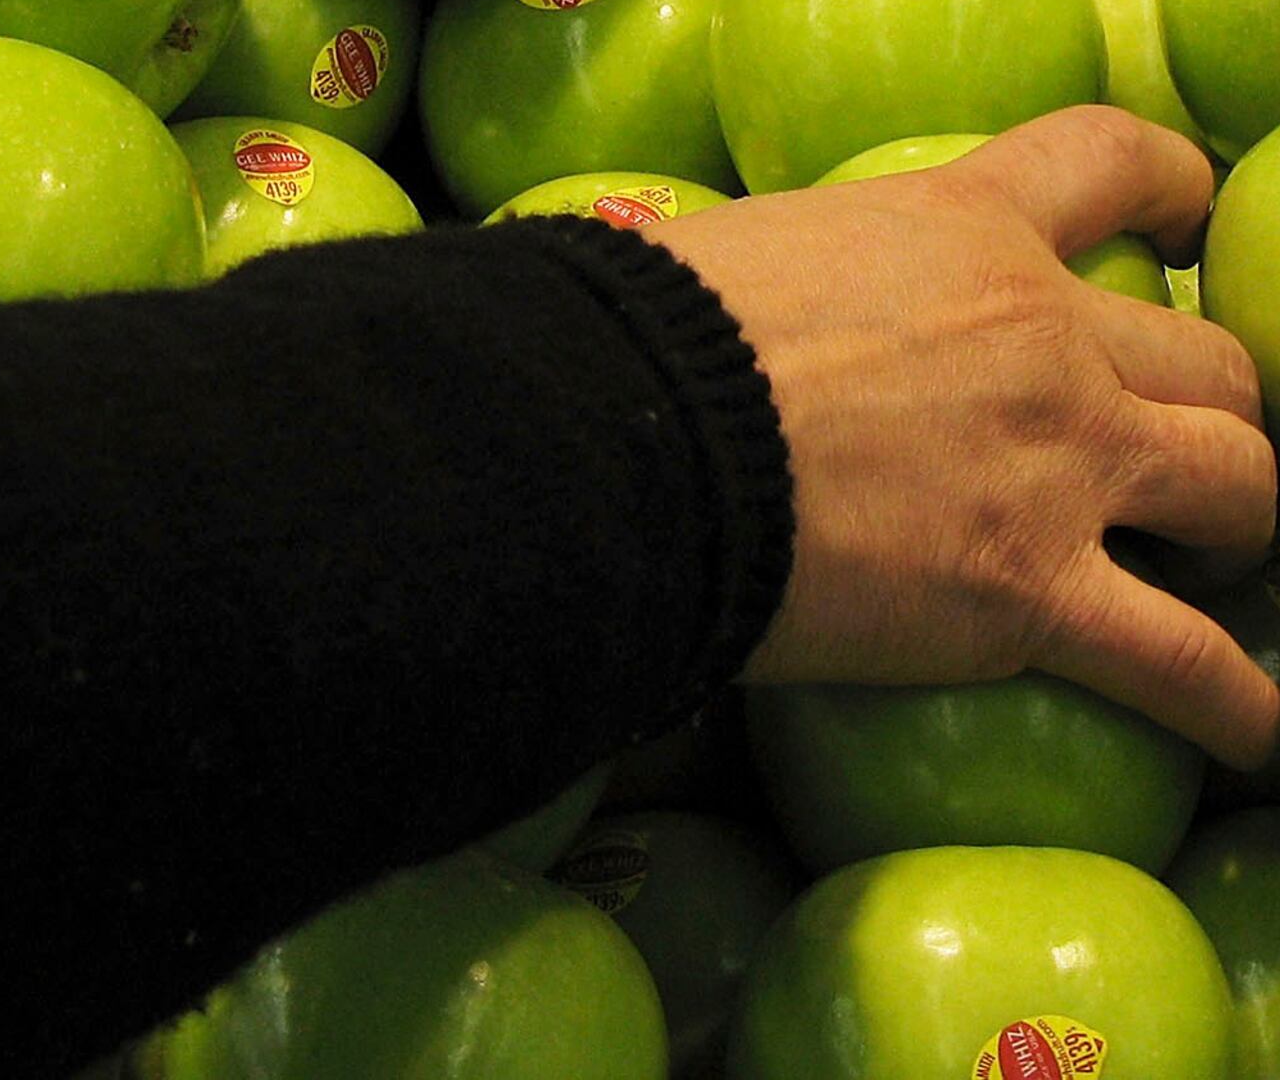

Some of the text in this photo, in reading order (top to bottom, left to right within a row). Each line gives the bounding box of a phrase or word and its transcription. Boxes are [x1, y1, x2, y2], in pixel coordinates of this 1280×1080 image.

[340, 33, 358, 56] GEE
[353, 59, 374, 97] WHIZ
[315, 70, 340, 101] 4139
[236, 152, 308, 165] GEE WHIZ
[266, 181, 297, 198] 4139
[598, 199, 631, 218] WHIZ
[1006, 1025, 1038, 1078] WHIZ
[1063, 1029, 1098, 1073] 4139
